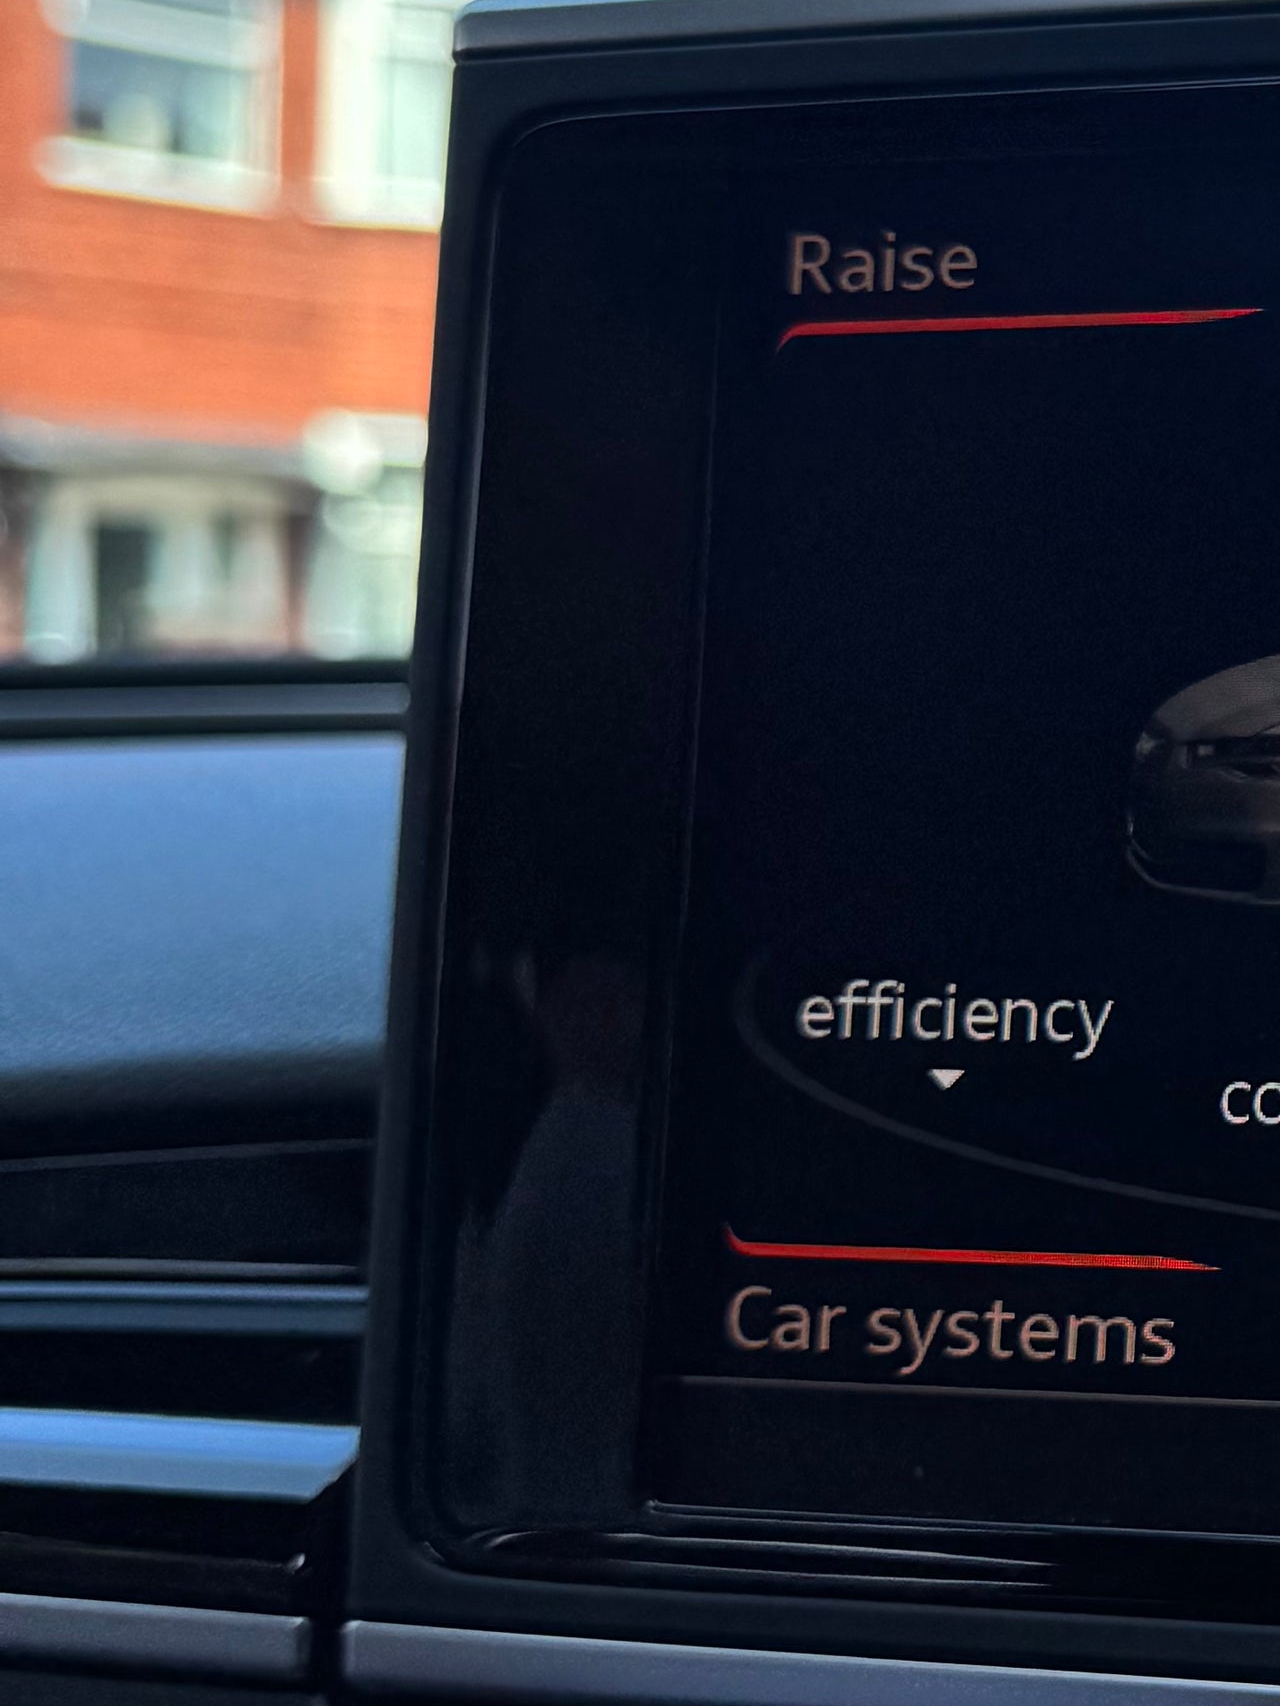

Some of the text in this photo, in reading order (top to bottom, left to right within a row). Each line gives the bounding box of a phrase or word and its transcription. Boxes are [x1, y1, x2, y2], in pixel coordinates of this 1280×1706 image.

[790, 230, 978, 296] Raise
[798, 977, 1115, 1061] efficiency
[727, 1284, 1177, 1376] Car systems
